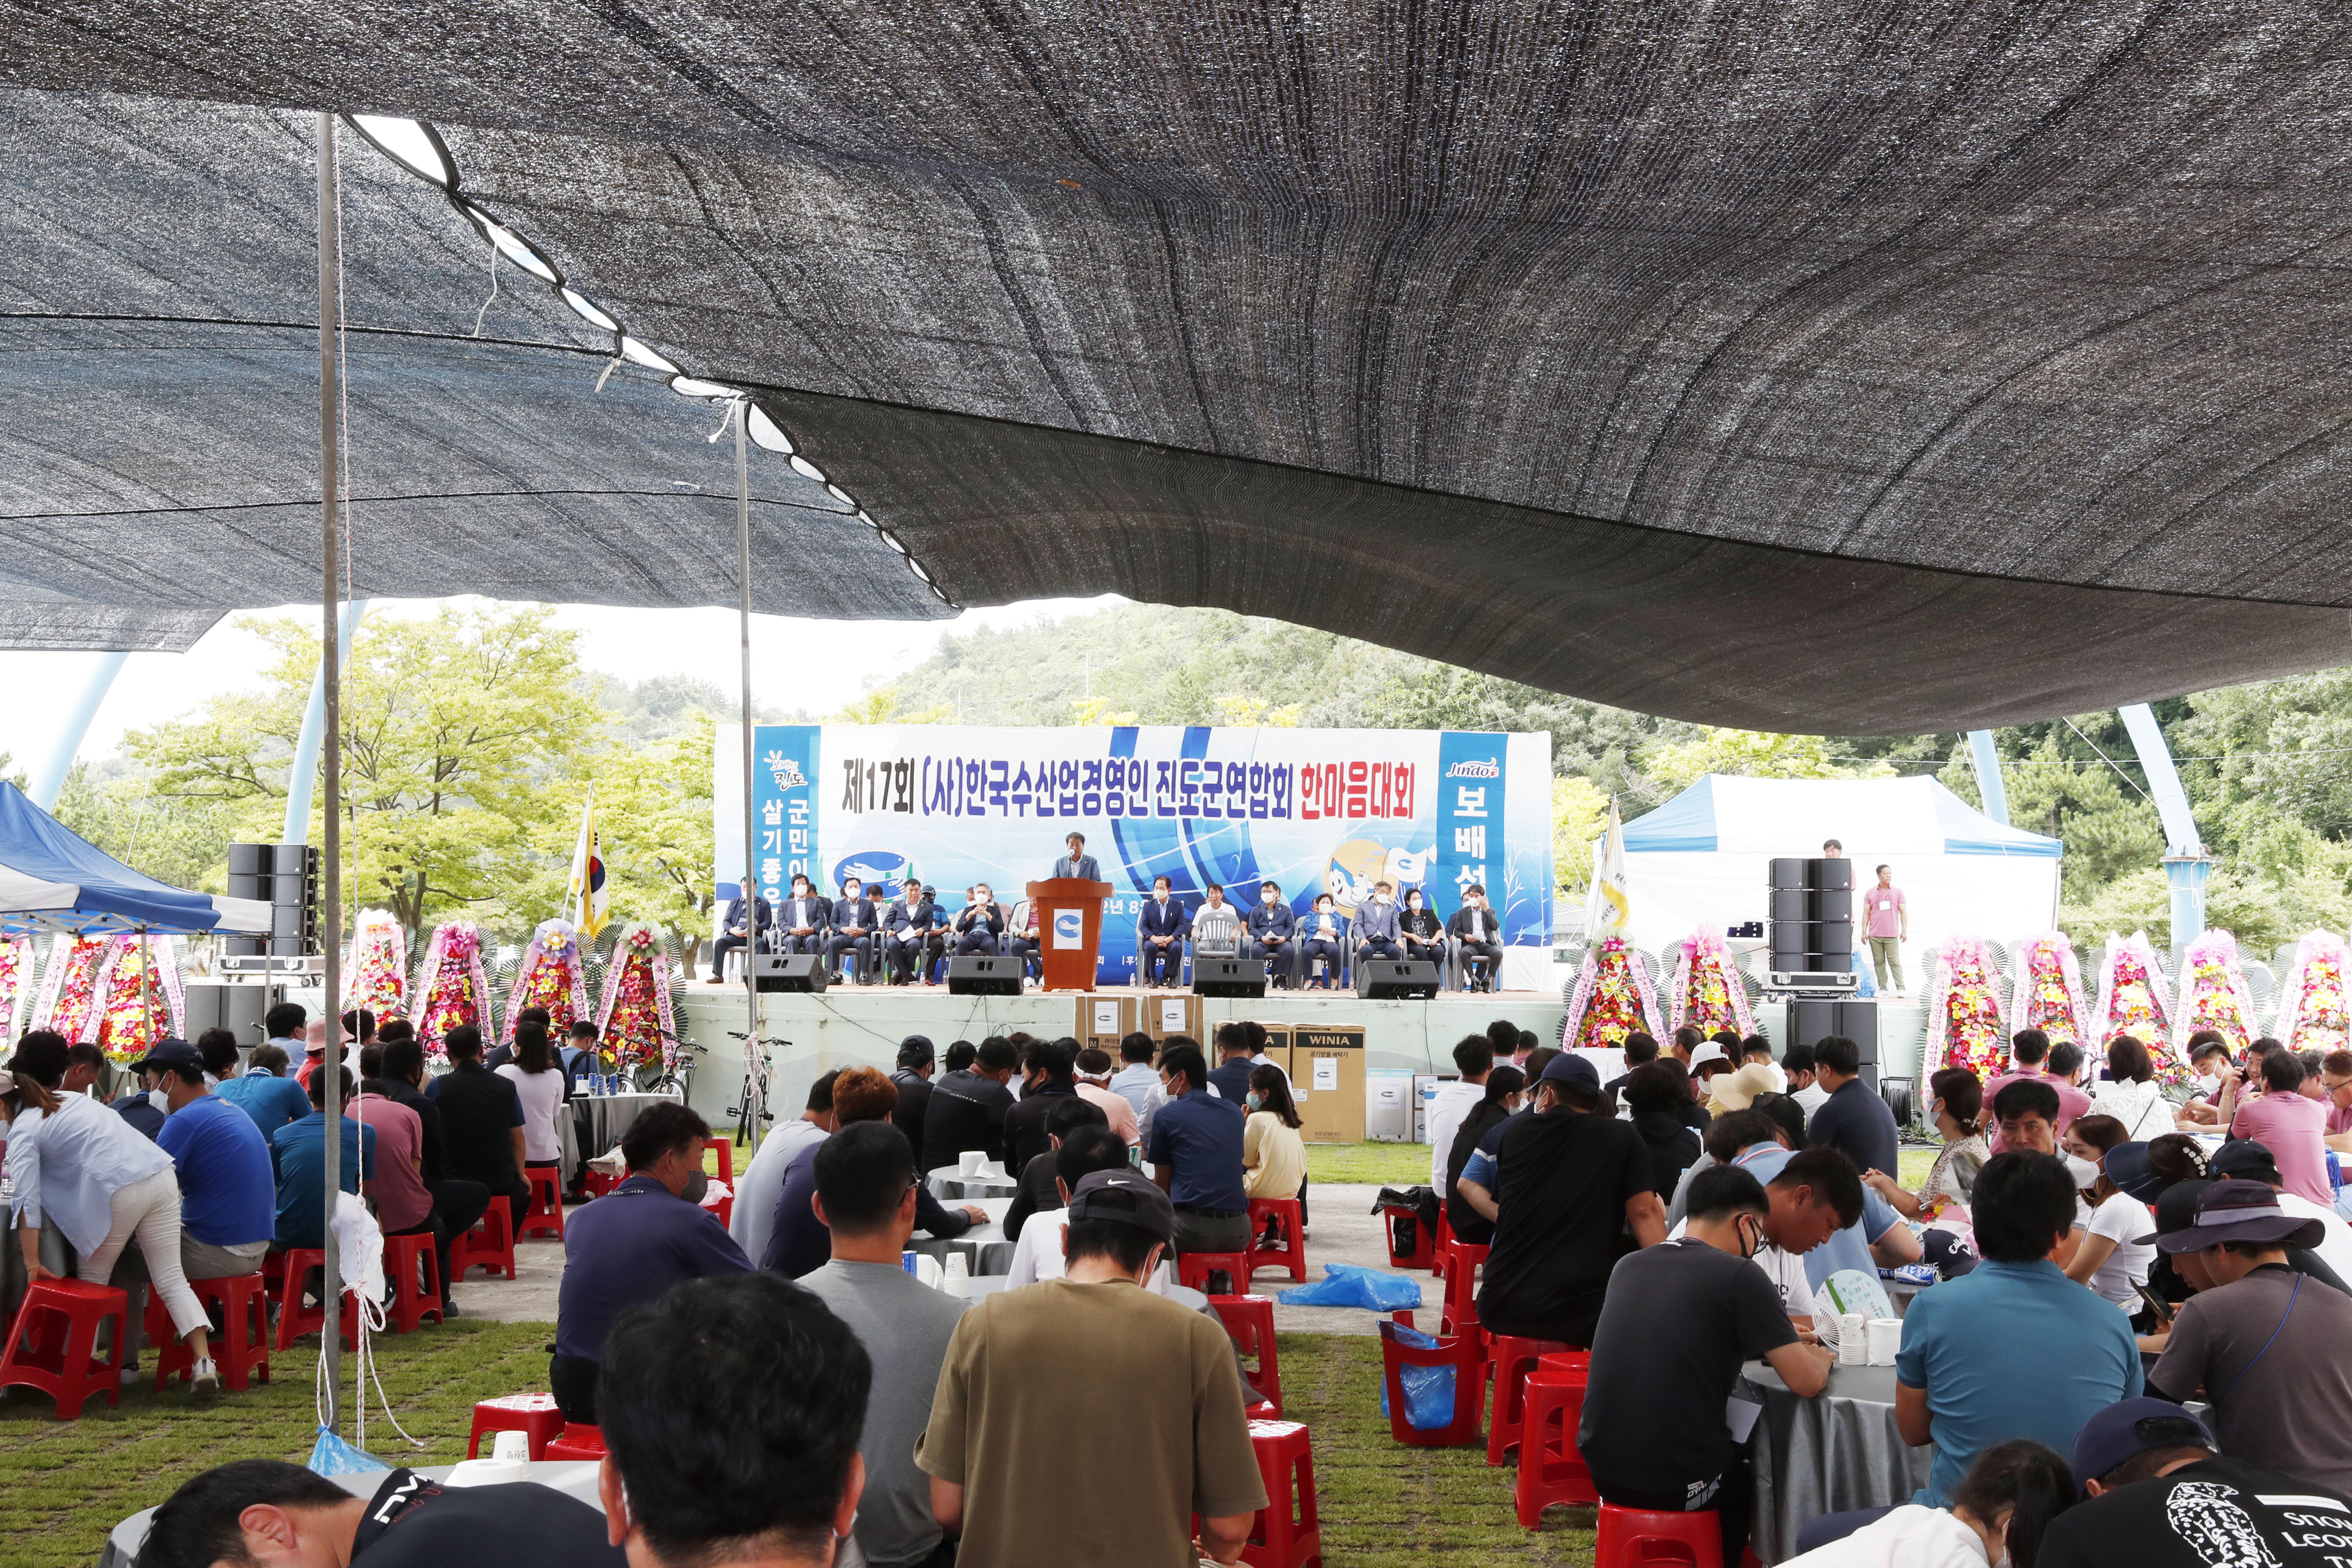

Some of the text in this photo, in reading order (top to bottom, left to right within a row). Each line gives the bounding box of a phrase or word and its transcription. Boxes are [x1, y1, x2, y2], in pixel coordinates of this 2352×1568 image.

[1446, 761, 1490, 778] Jindo
[775, 772, 807, 790] 진도
[842, 757, 914, 814] 제17회
[1156, 759, 1293, 820] 진도군연합회
[1300, 761, 1415, 820] 한마음대회
[571, 977, 586, 1022] 수산업경영
[1309, 1035, 1350, 1045] WINIA
